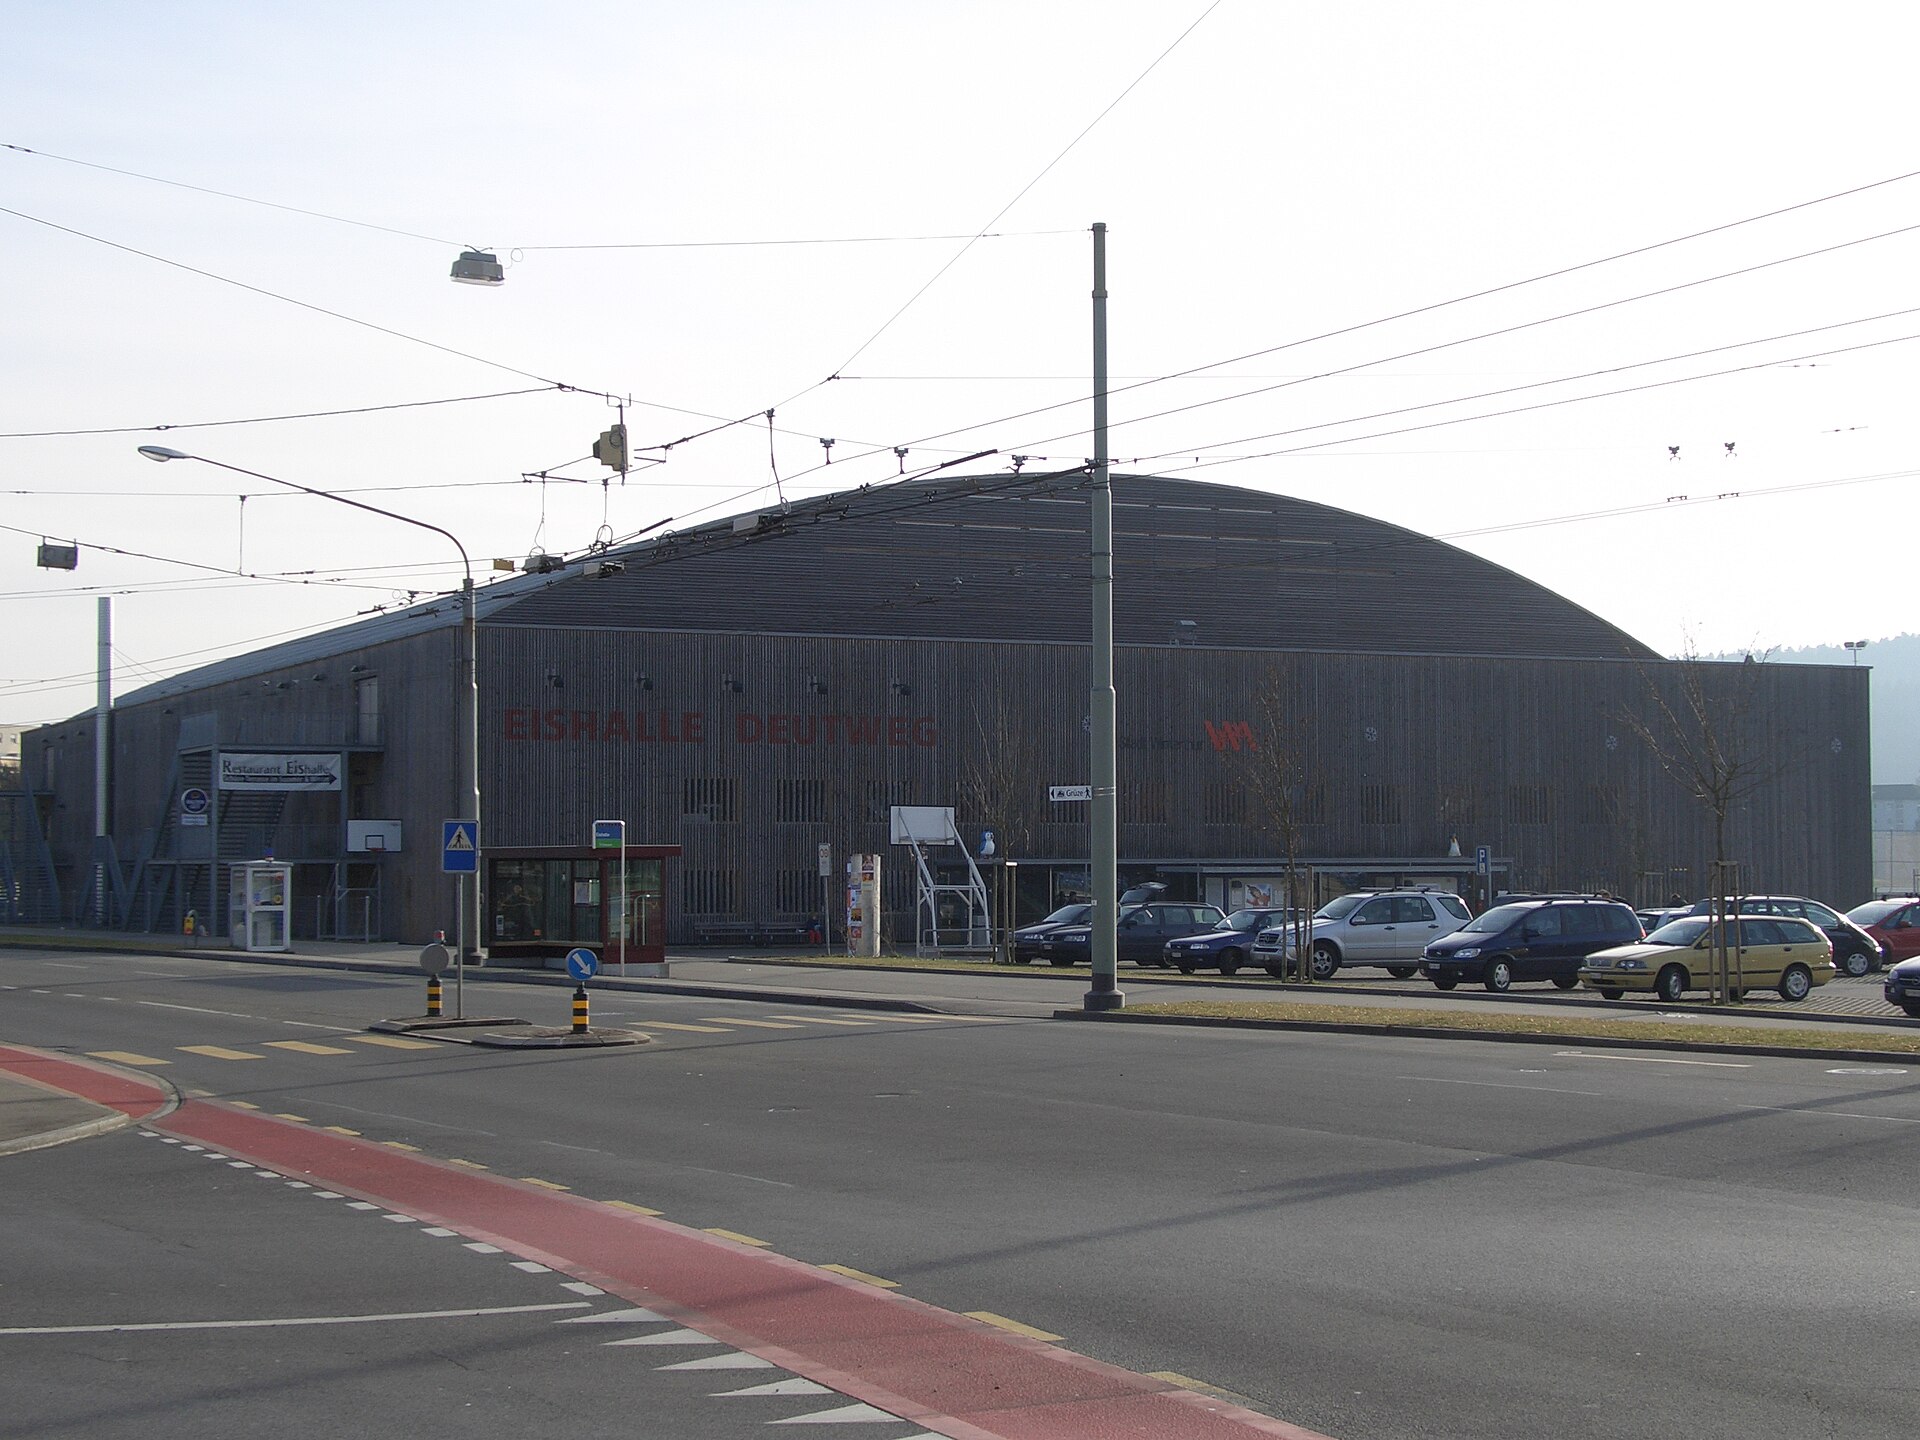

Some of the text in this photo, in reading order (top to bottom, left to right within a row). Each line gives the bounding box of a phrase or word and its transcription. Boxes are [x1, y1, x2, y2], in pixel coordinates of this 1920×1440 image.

[504, 707, 938, 748] EISHALLE DEUTWEG
[222, 759, 281, 775] Restaurant
